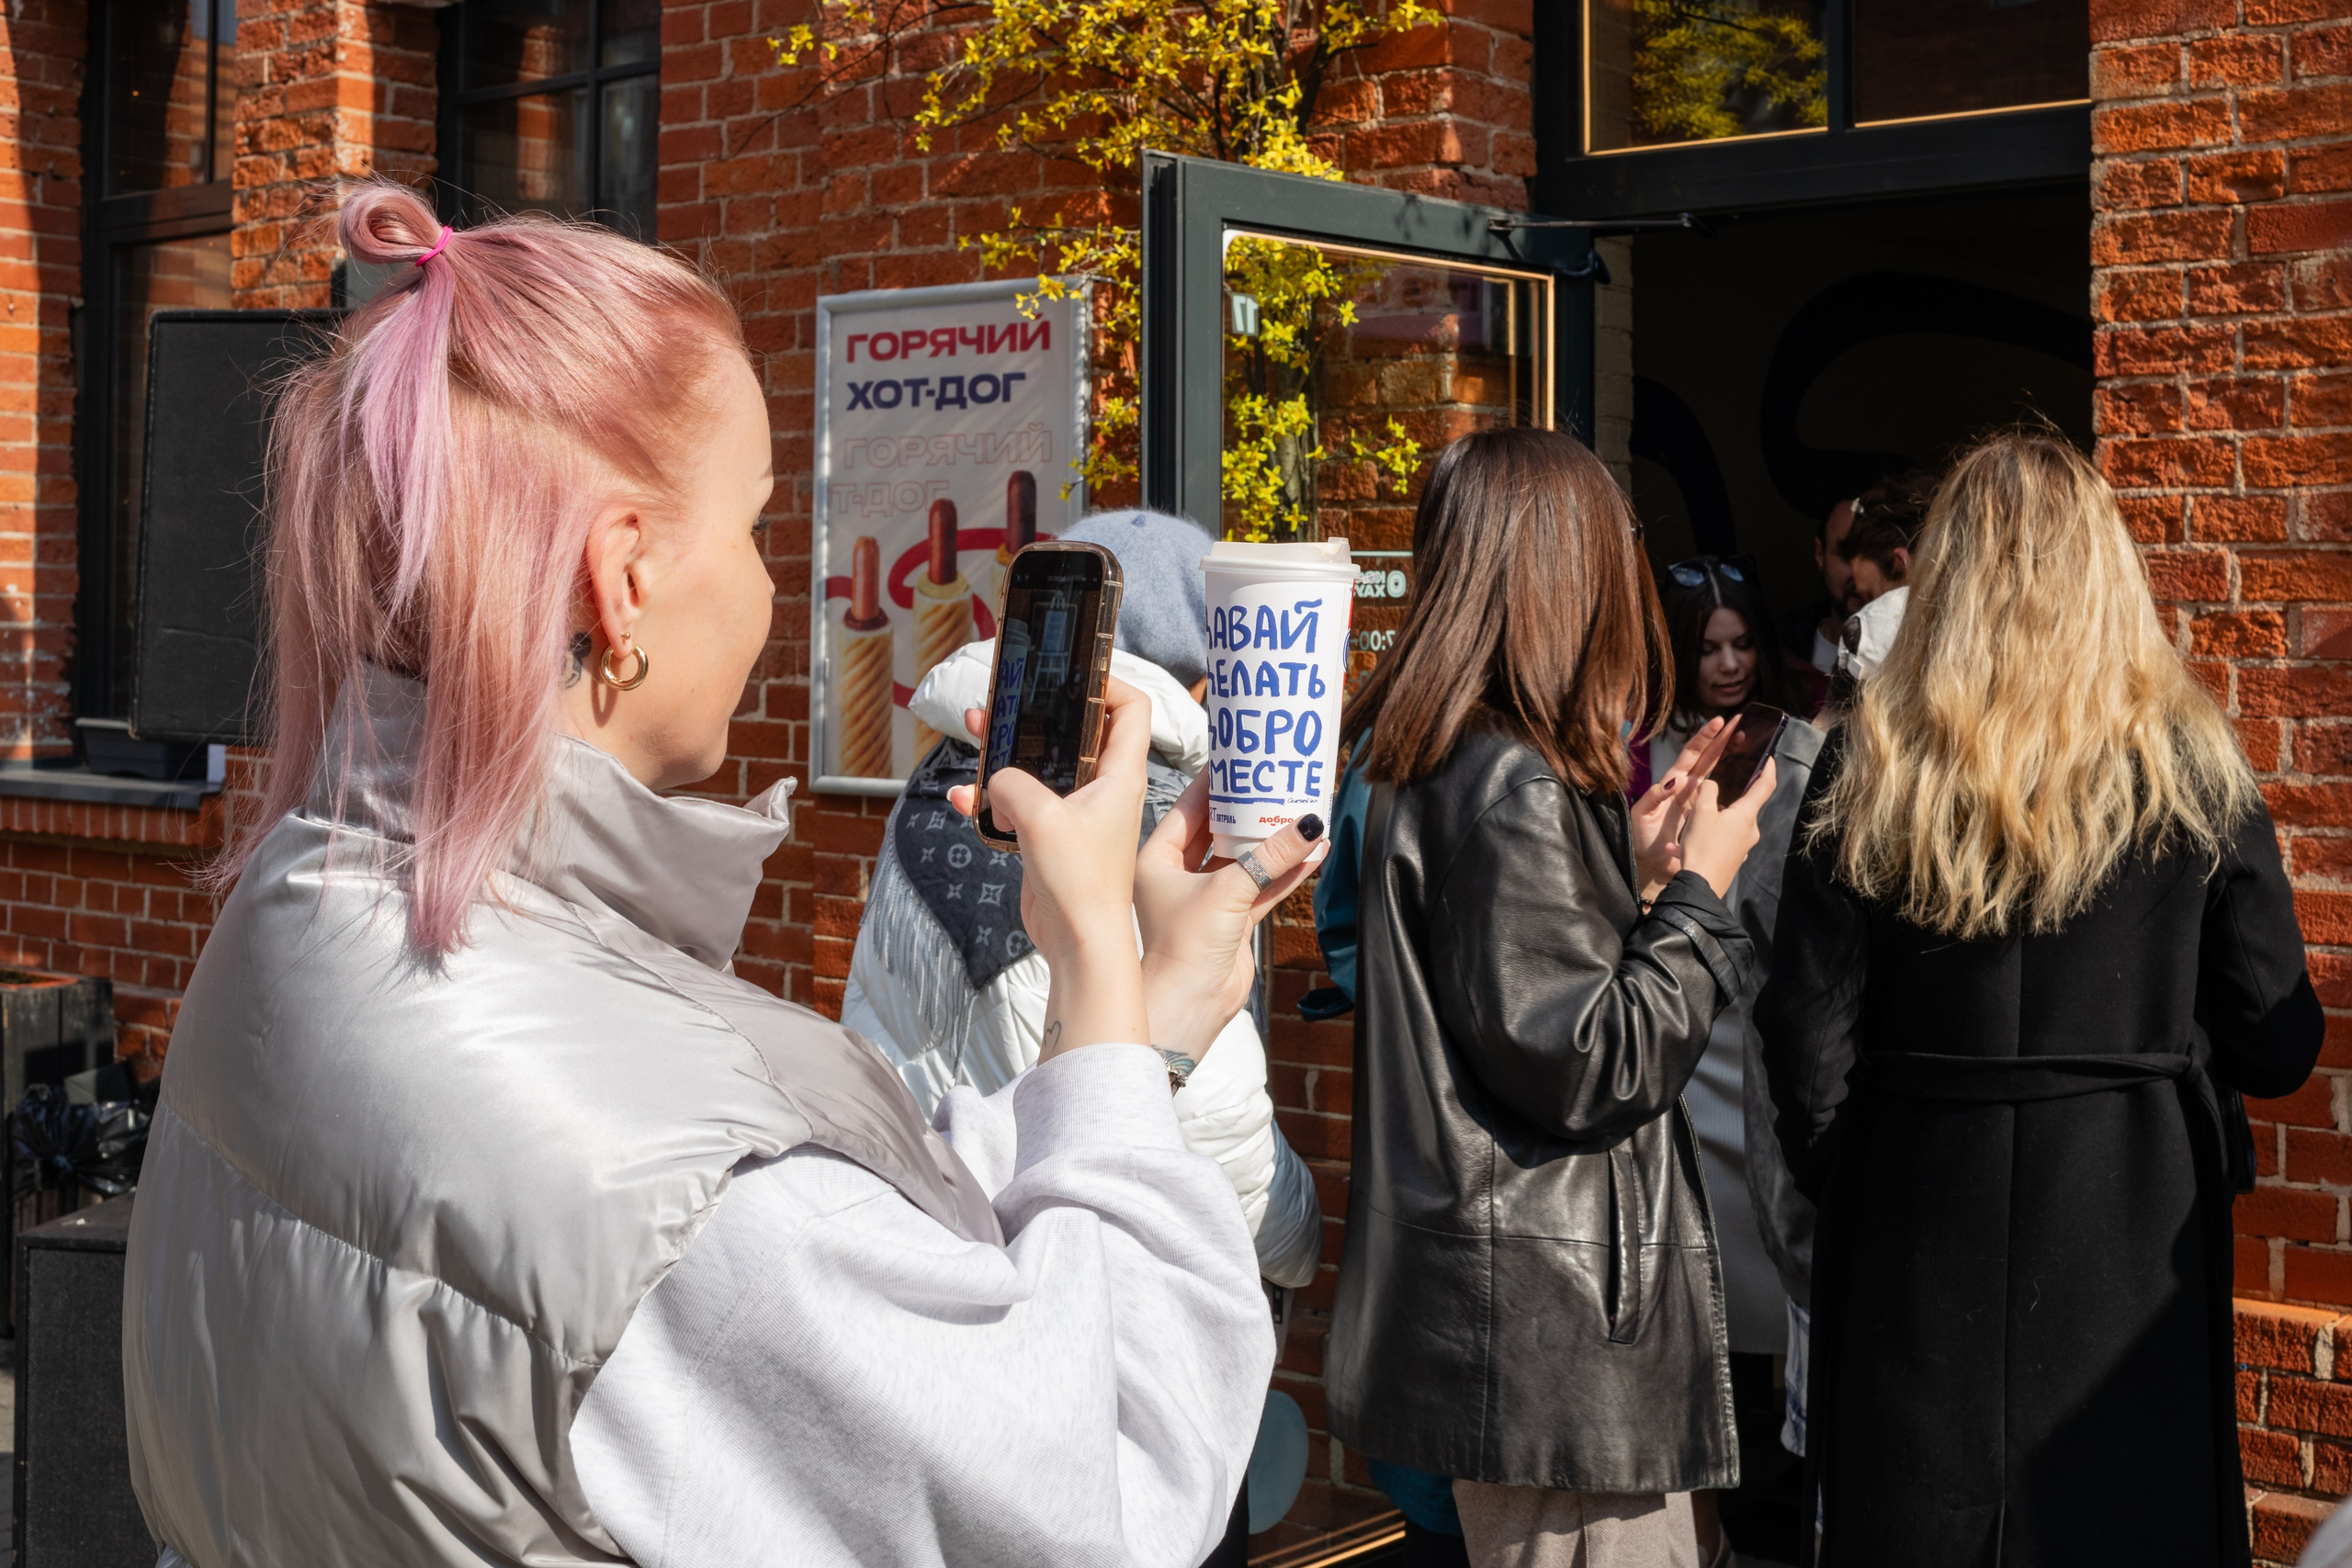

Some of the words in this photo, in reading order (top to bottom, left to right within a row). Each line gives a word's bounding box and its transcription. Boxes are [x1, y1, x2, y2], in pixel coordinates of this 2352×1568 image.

[847, 313, 1050, 363] ГОРЯЧИЙ
[846, 372, 1026, 411] ХОТ-ДОГ
[843, 423, 1053, 469] ГОРЯЧИЙ
[829, 480, 950, 518] Т-ДОГ
[1209, 759, 1323, 797] МЕСТЕ
